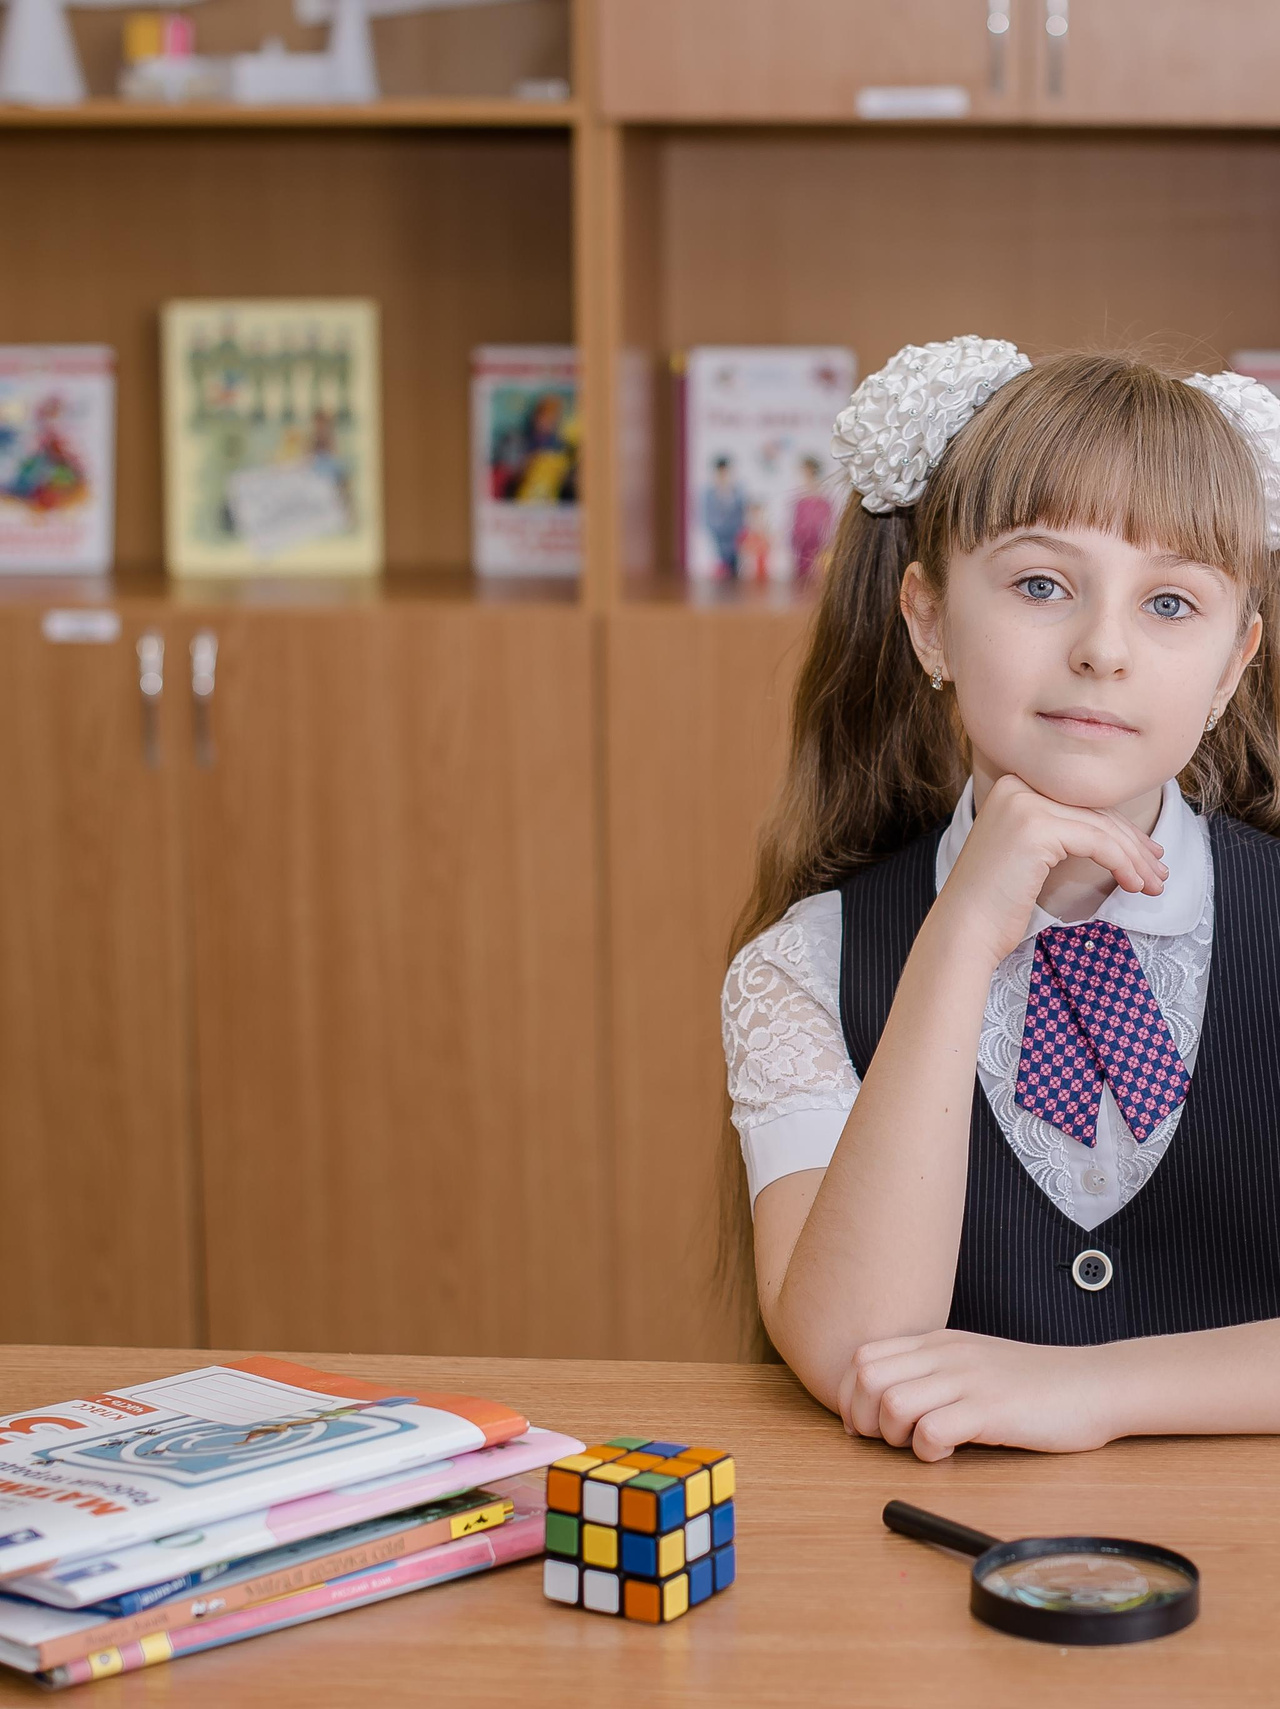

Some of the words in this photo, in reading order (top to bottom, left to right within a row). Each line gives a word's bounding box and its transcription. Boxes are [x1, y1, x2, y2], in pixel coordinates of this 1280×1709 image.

[72, 1403, 128, 1421] класс
[111, 1400, 145, 1414] часть
[67, 1478, 160, 1506] Рабочая
